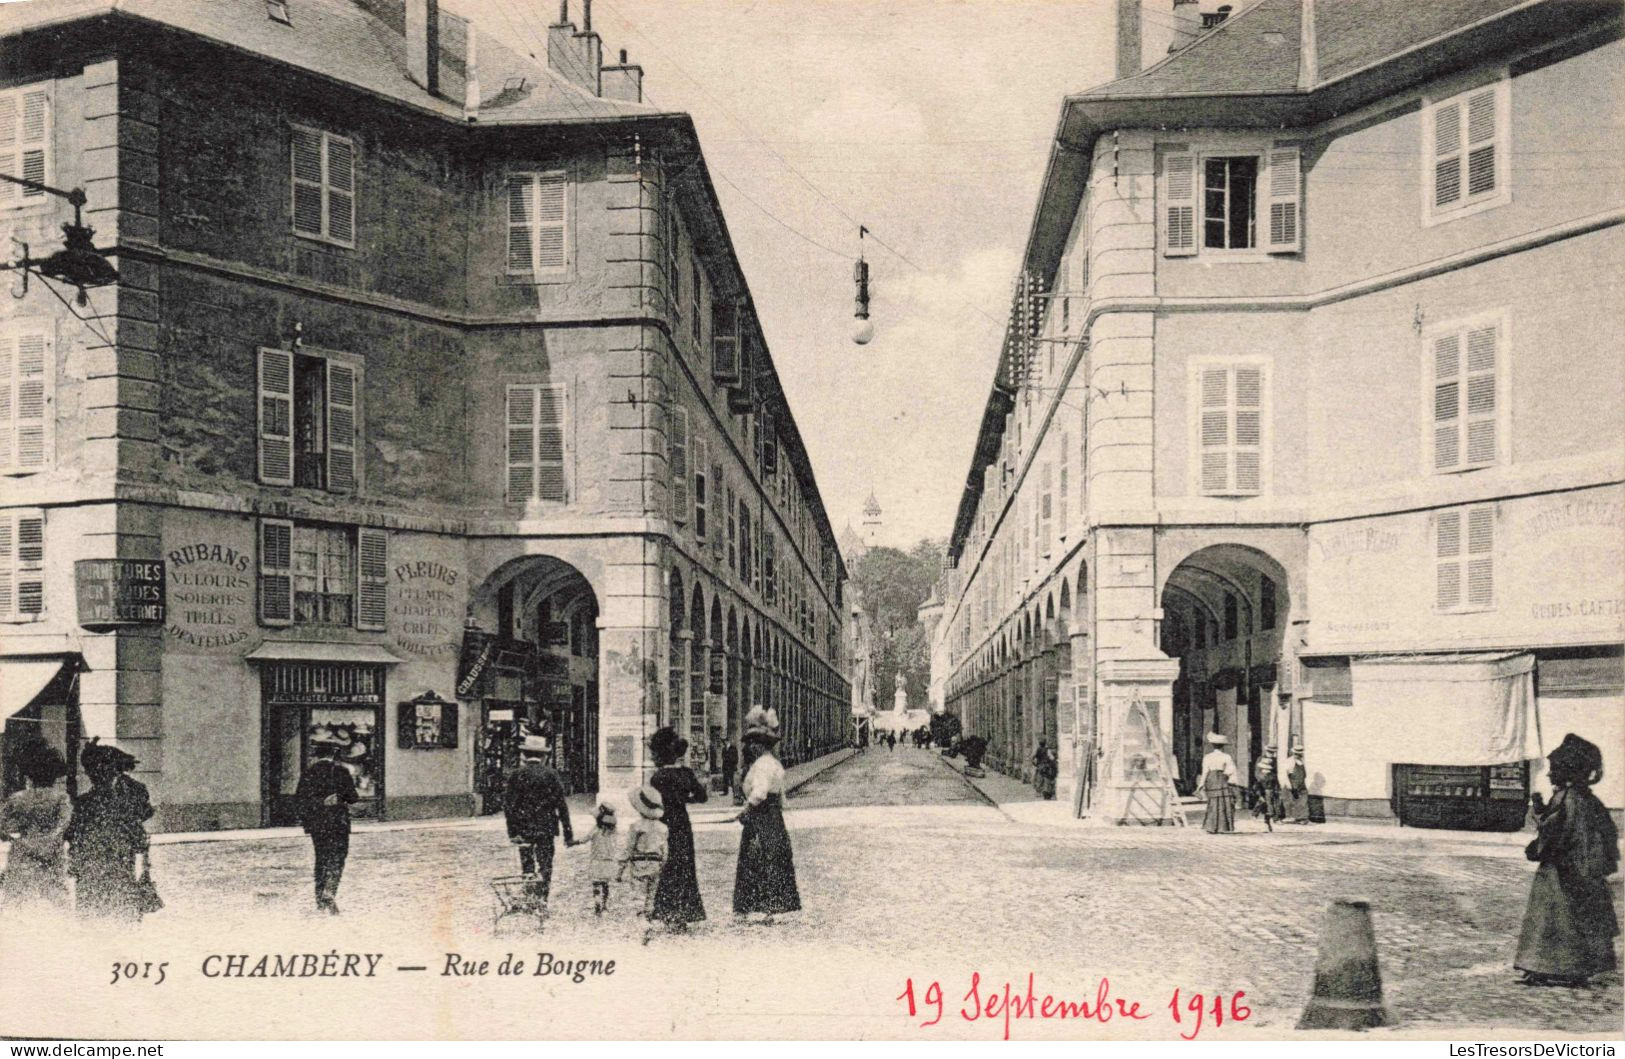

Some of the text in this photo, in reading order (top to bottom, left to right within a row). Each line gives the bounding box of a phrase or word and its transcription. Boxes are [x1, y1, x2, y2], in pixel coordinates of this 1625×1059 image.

[168, 543, 250, 571] RUBANS
[170, 571, 249, 588] VELOURS
[174, 592, 246, 606] SOIERIES
[184, 610, 236, 625] TULLES
[169, 624, 249, 648] DENTELLES
[898, 972, 1252, 1041] 19 Septembre 1916
